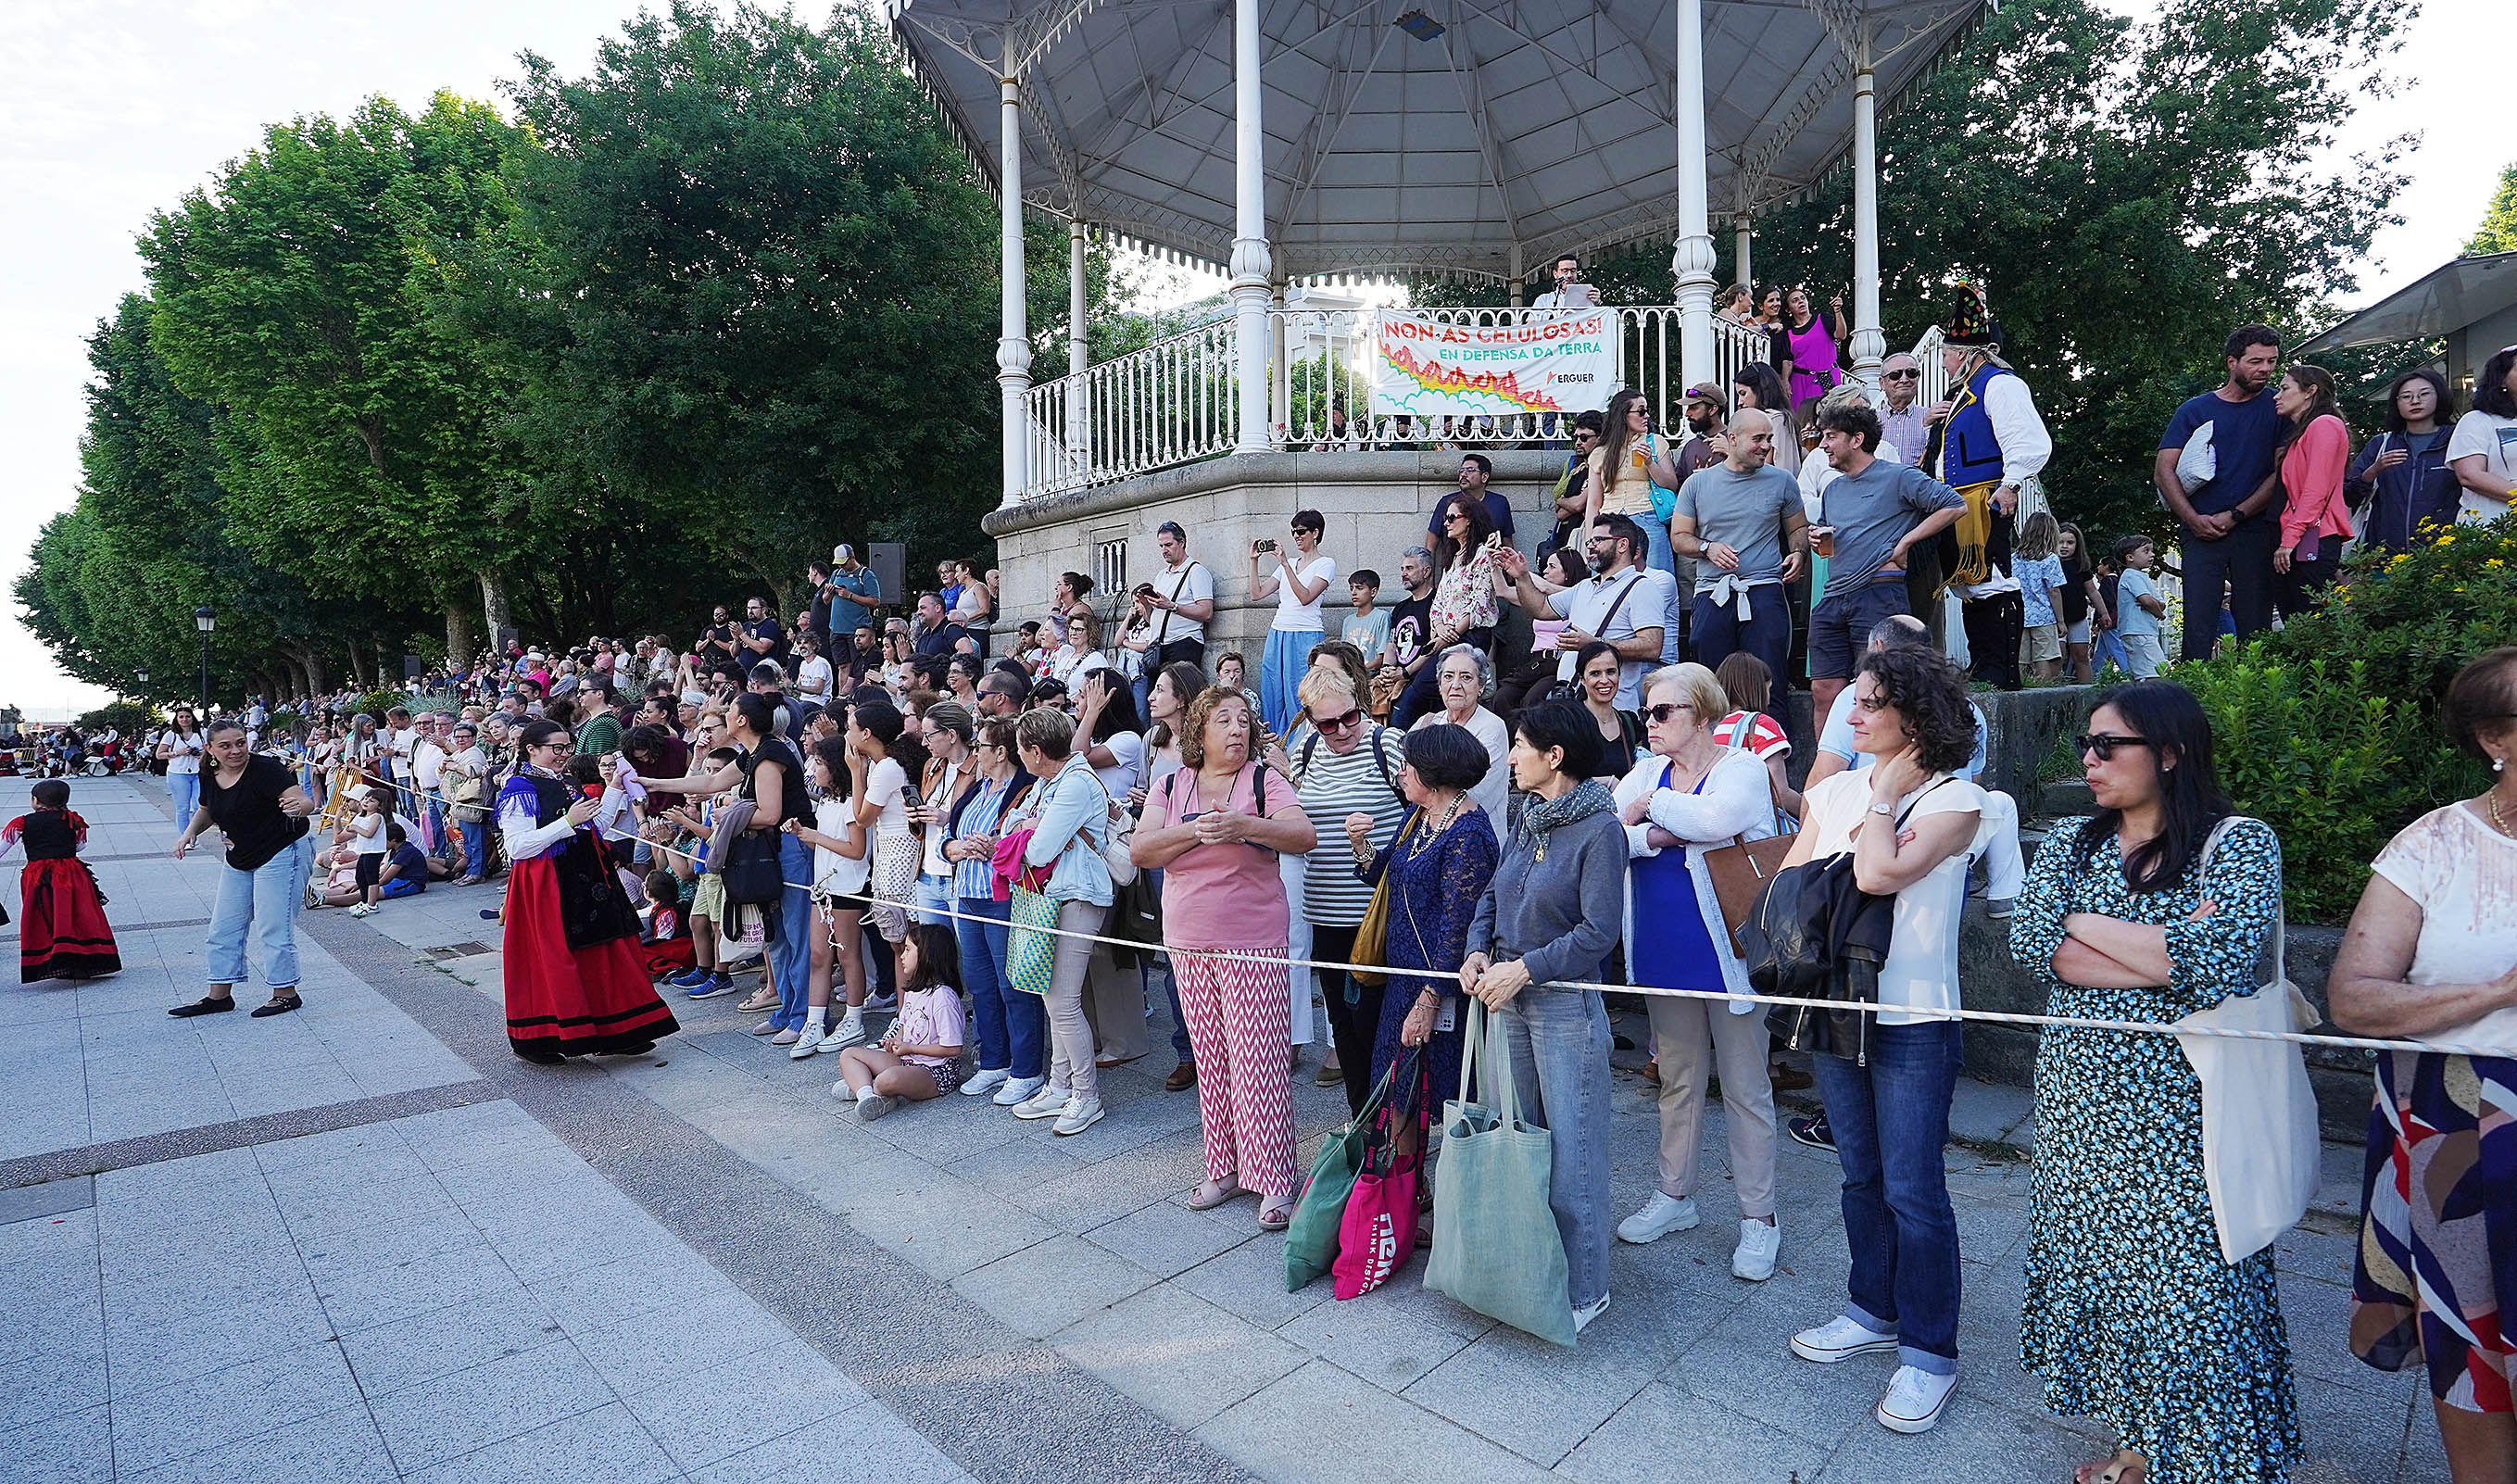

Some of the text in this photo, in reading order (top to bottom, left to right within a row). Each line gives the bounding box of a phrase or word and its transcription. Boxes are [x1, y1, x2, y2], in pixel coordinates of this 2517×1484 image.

[1385, 321, 1434, 341] NON
[1477, 317, 1602, 344] CELULOSAS!
[1440, 342, 1602, 360] EN DEFENSA DA TERRA
[1557, 373, 1594, 383] ERGUER
[1369, 1215, 1379, 1254] THINK
